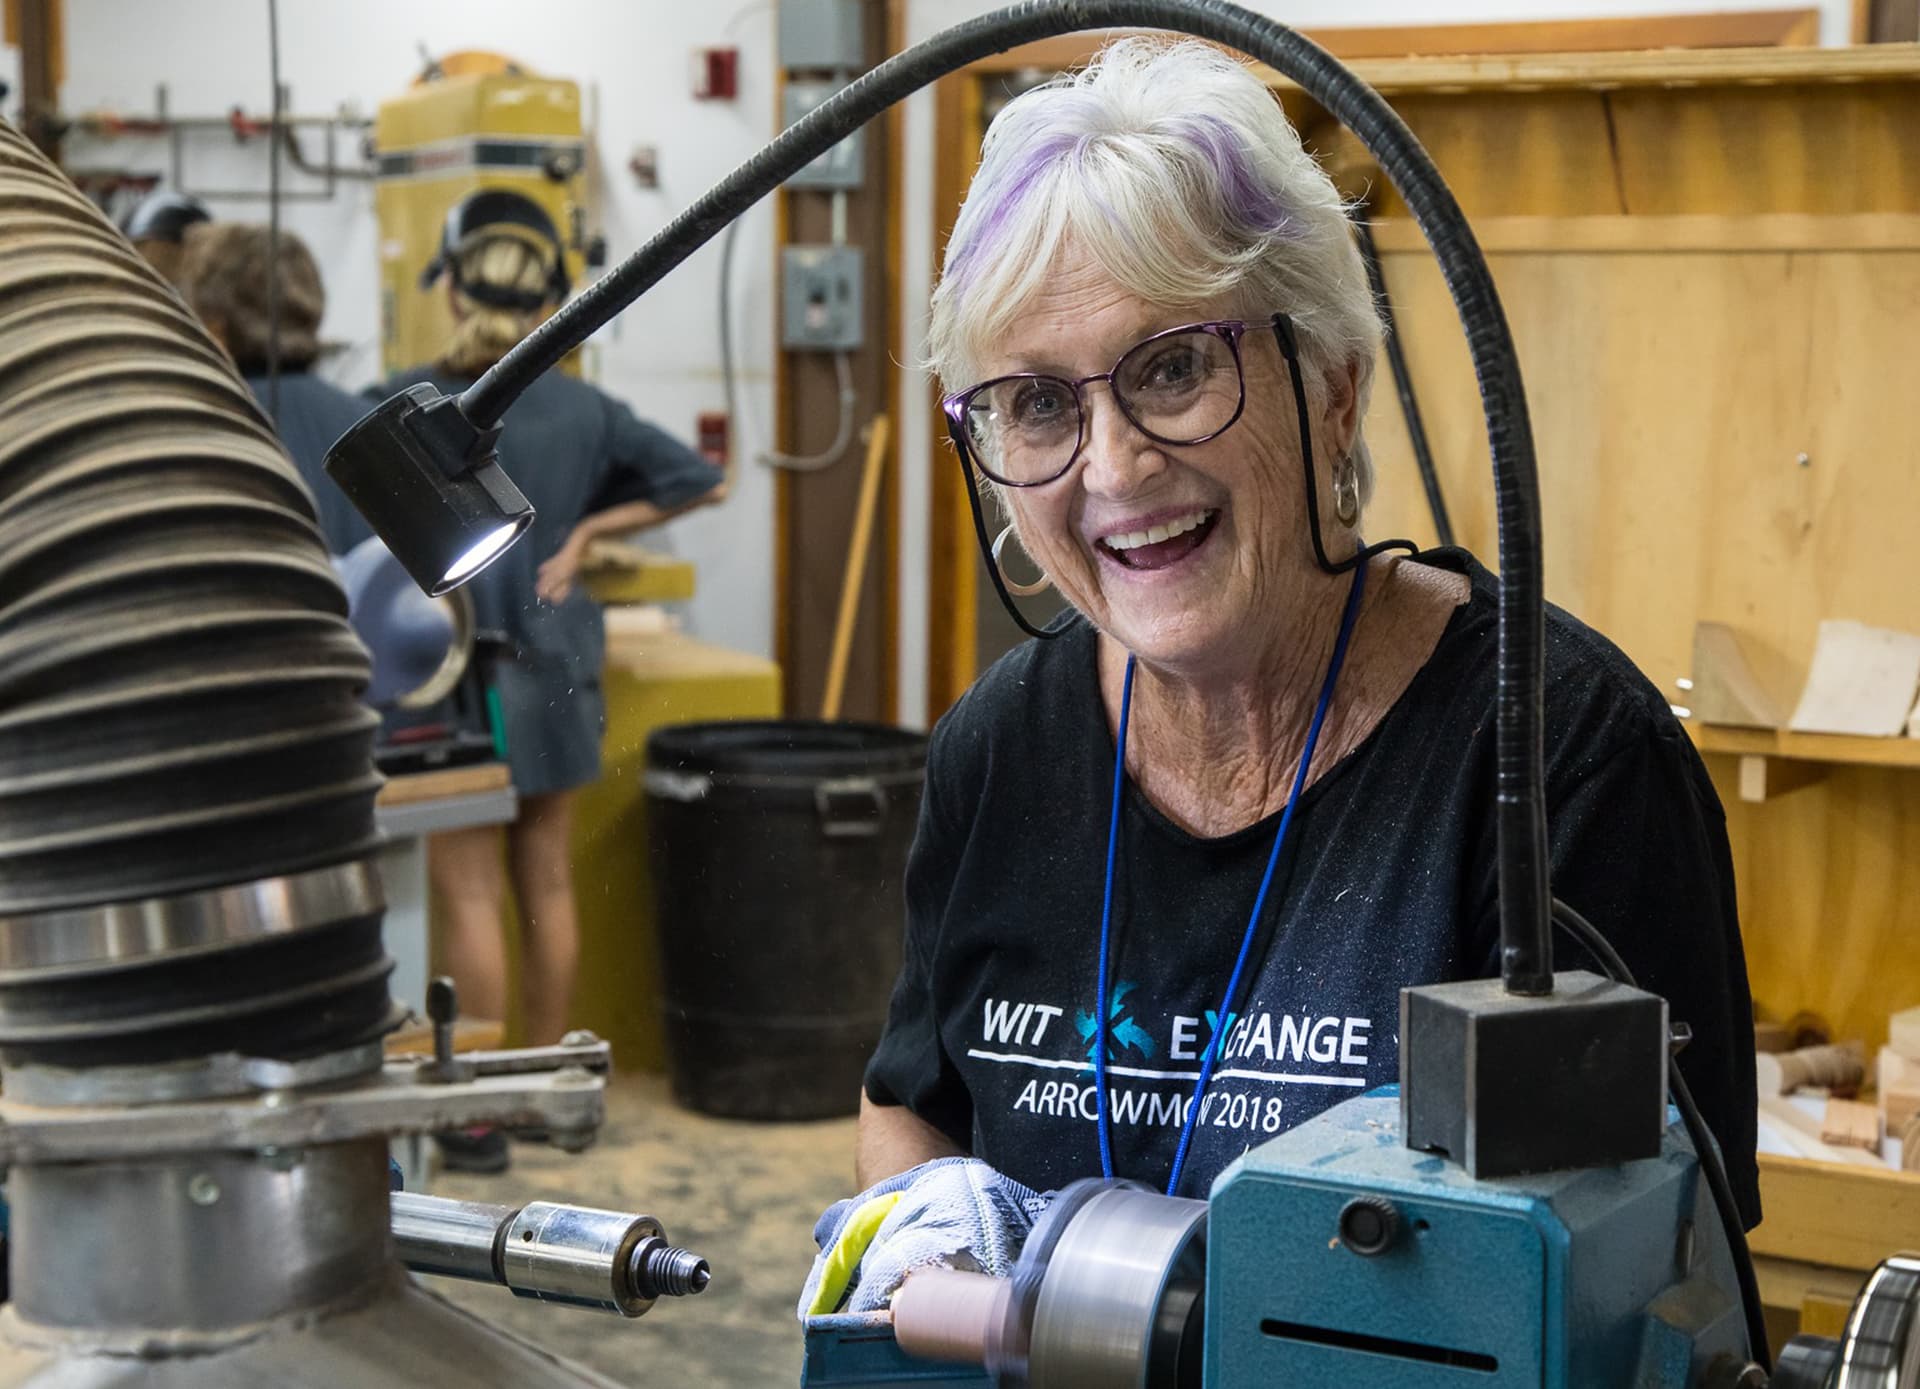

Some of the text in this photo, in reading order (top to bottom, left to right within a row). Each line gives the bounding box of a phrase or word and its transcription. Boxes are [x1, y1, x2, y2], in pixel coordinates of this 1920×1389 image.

[983, 998, 1371, 1065] WIT EXCHANGE
[1213, 1091, 1283, 1133] 2018
